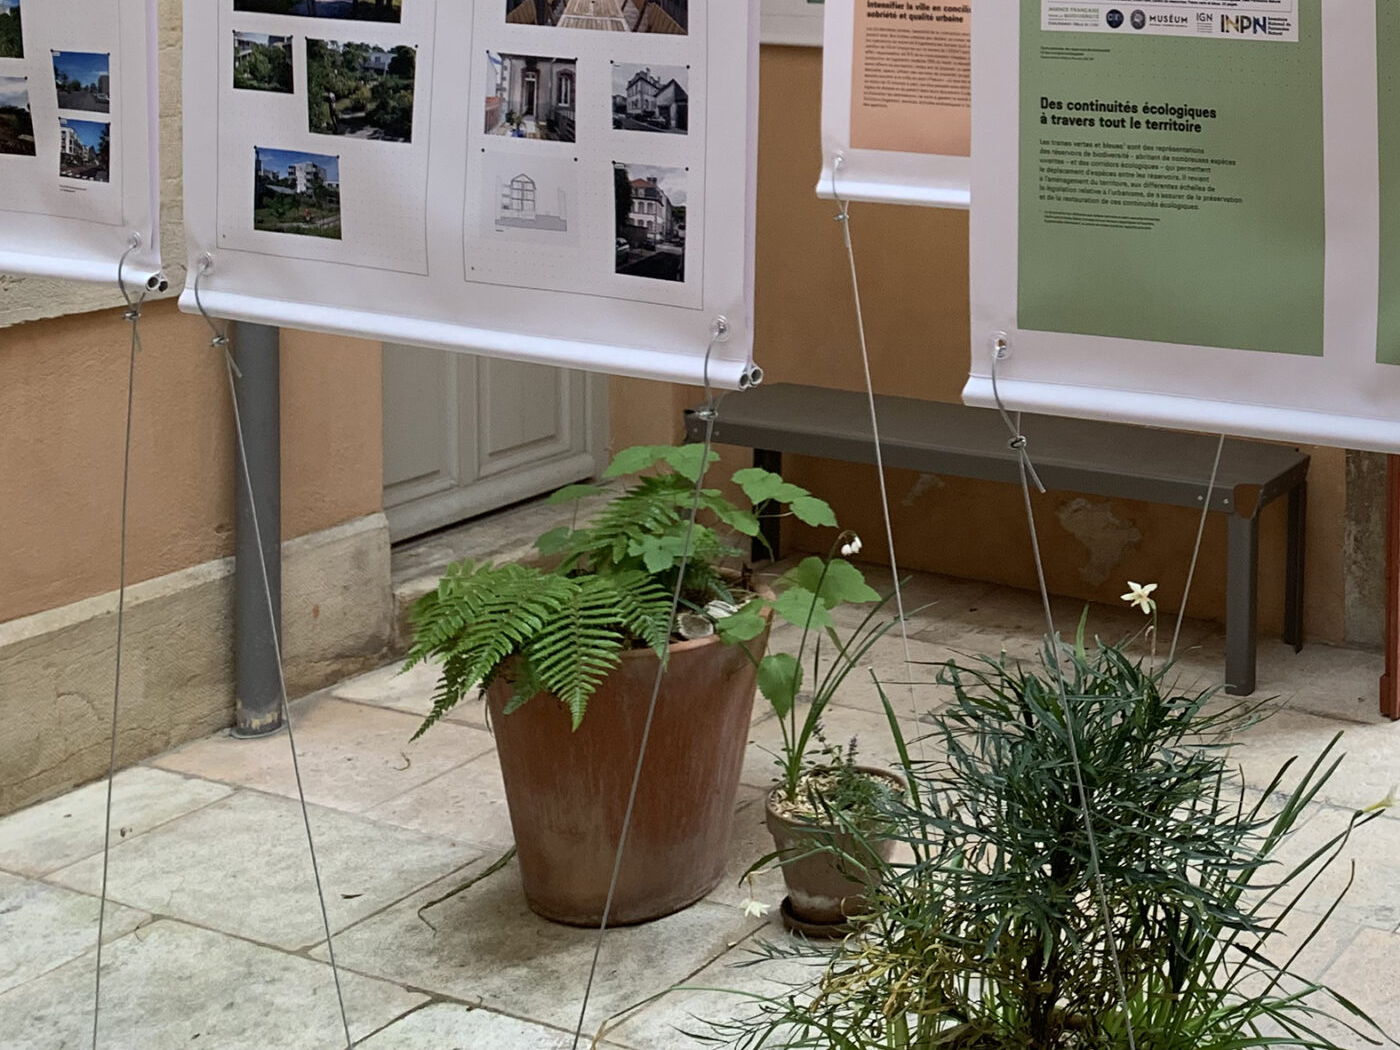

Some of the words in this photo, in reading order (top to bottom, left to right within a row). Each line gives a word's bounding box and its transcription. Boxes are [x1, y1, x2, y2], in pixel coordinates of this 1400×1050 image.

[867, 0, 904, 9] Intensifier
[906, 2, 913, 10] la
[915, 2, 930, 11] ville
[866, 10, 897, 19] sobriété
[908, 12, 934, 21] qualité
[935, 14, 963, 23] urbaine
[1149, 13, 1188, 25] MUSÉUM
[1196, 12, 1213, 22] IGN
[1220, 14, 1266, 34] INPN
[1040, 96, 1062, 110] Des
[1066, 99, 1138, 114] continuités
[1142, 101, 1216, 120] écologiques
[1040, 112, 1047, 124] à
[1051, 114, 1094, 127] travers
[1098, 116, 1126, 128] tout
[1129, 116, 1141, 129] le
[1145, 118, 1201, 133] territoire
